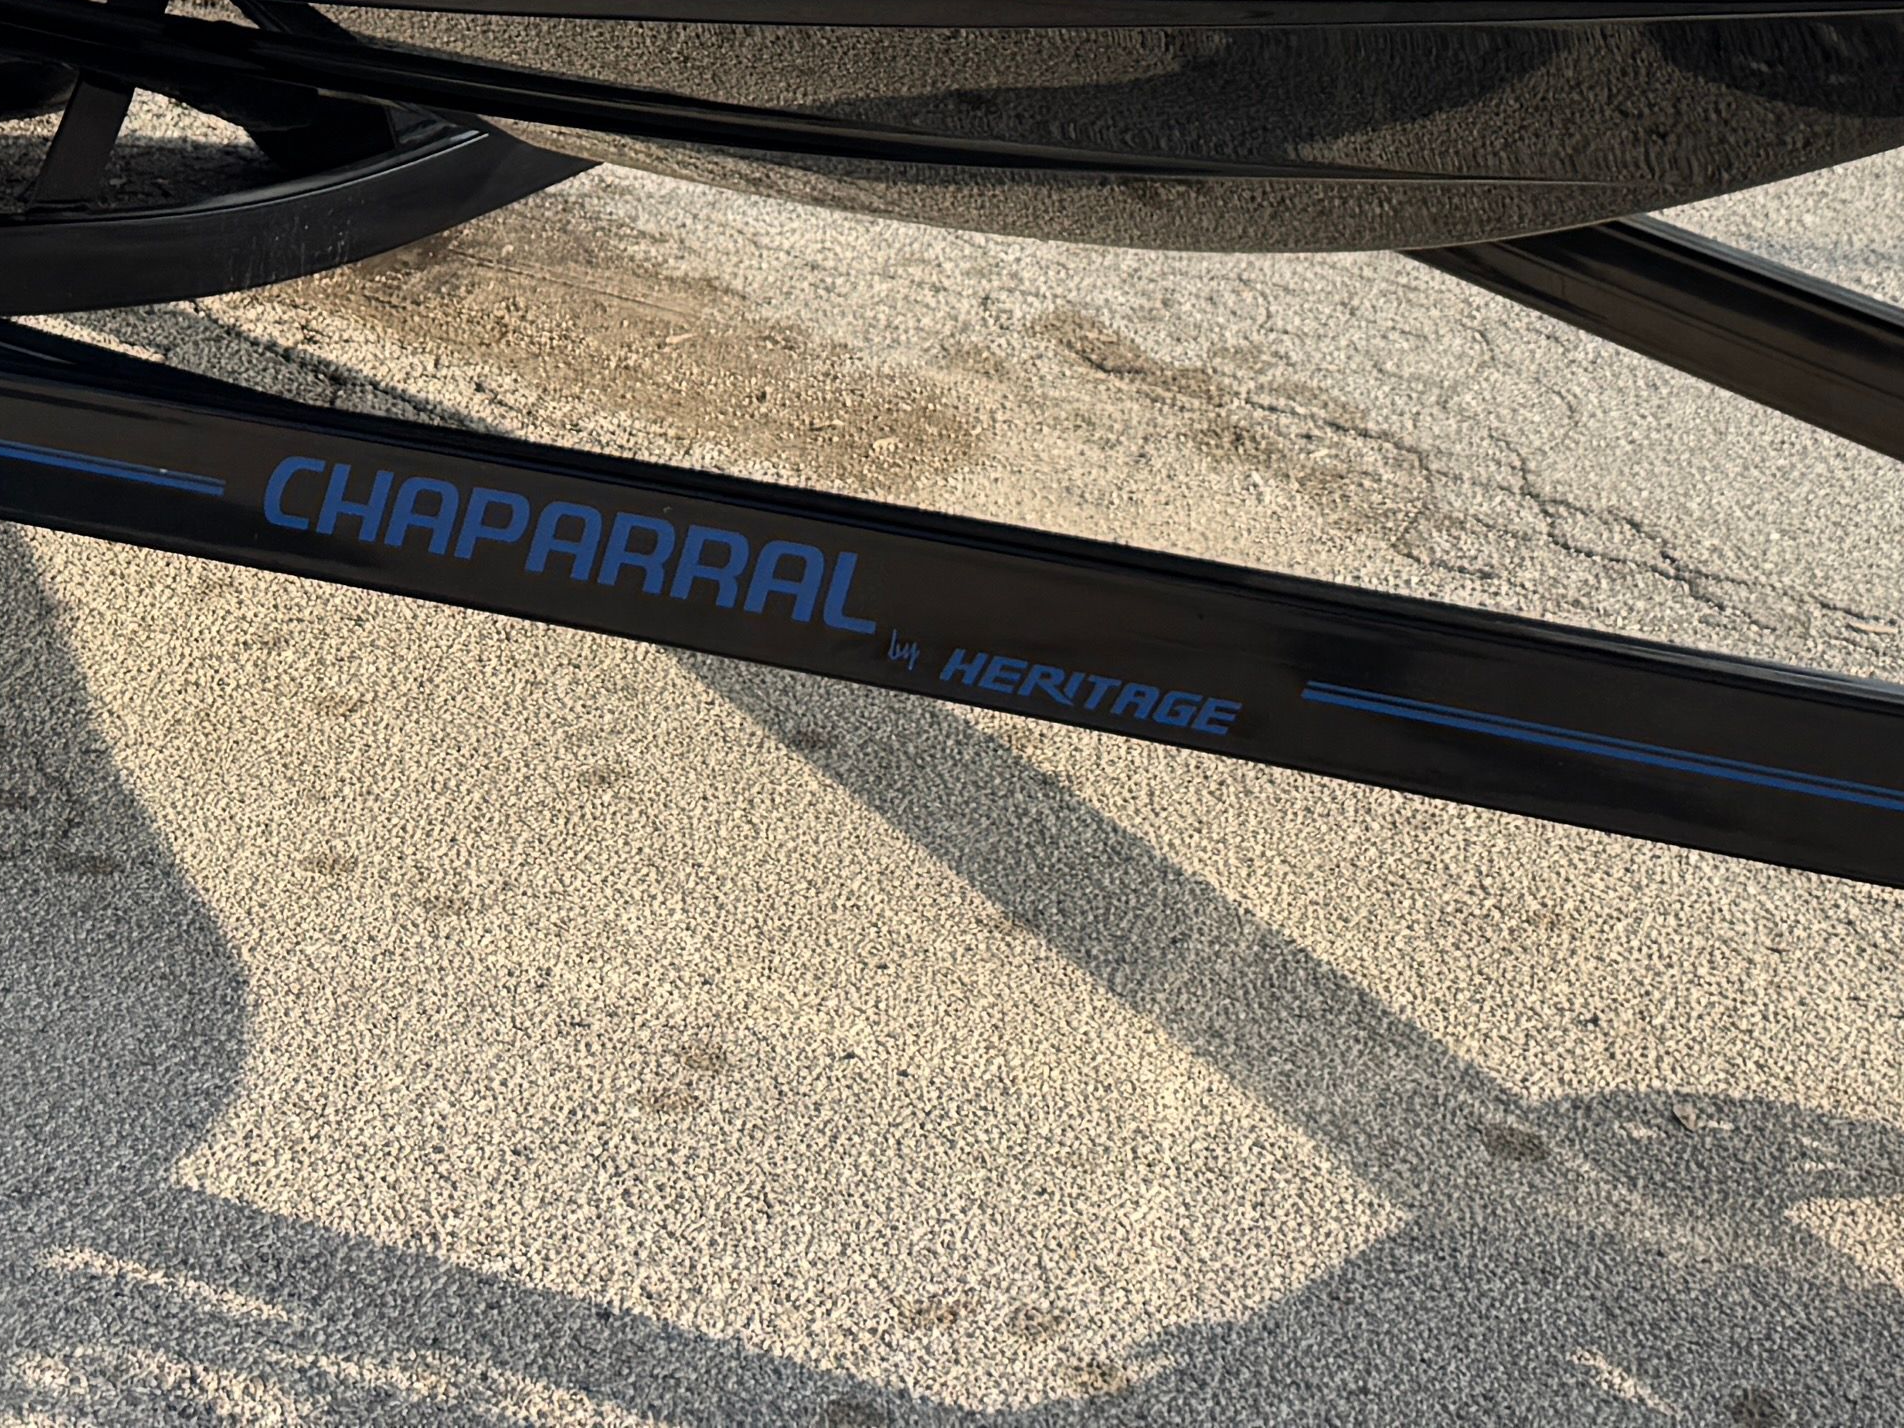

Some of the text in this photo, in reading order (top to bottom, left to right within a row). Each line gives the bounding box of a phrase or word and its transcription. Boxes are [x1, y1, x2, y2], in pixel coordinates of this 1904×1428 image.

[264, 456, 1242, 735] CHAPARRAL by HERITAGE
